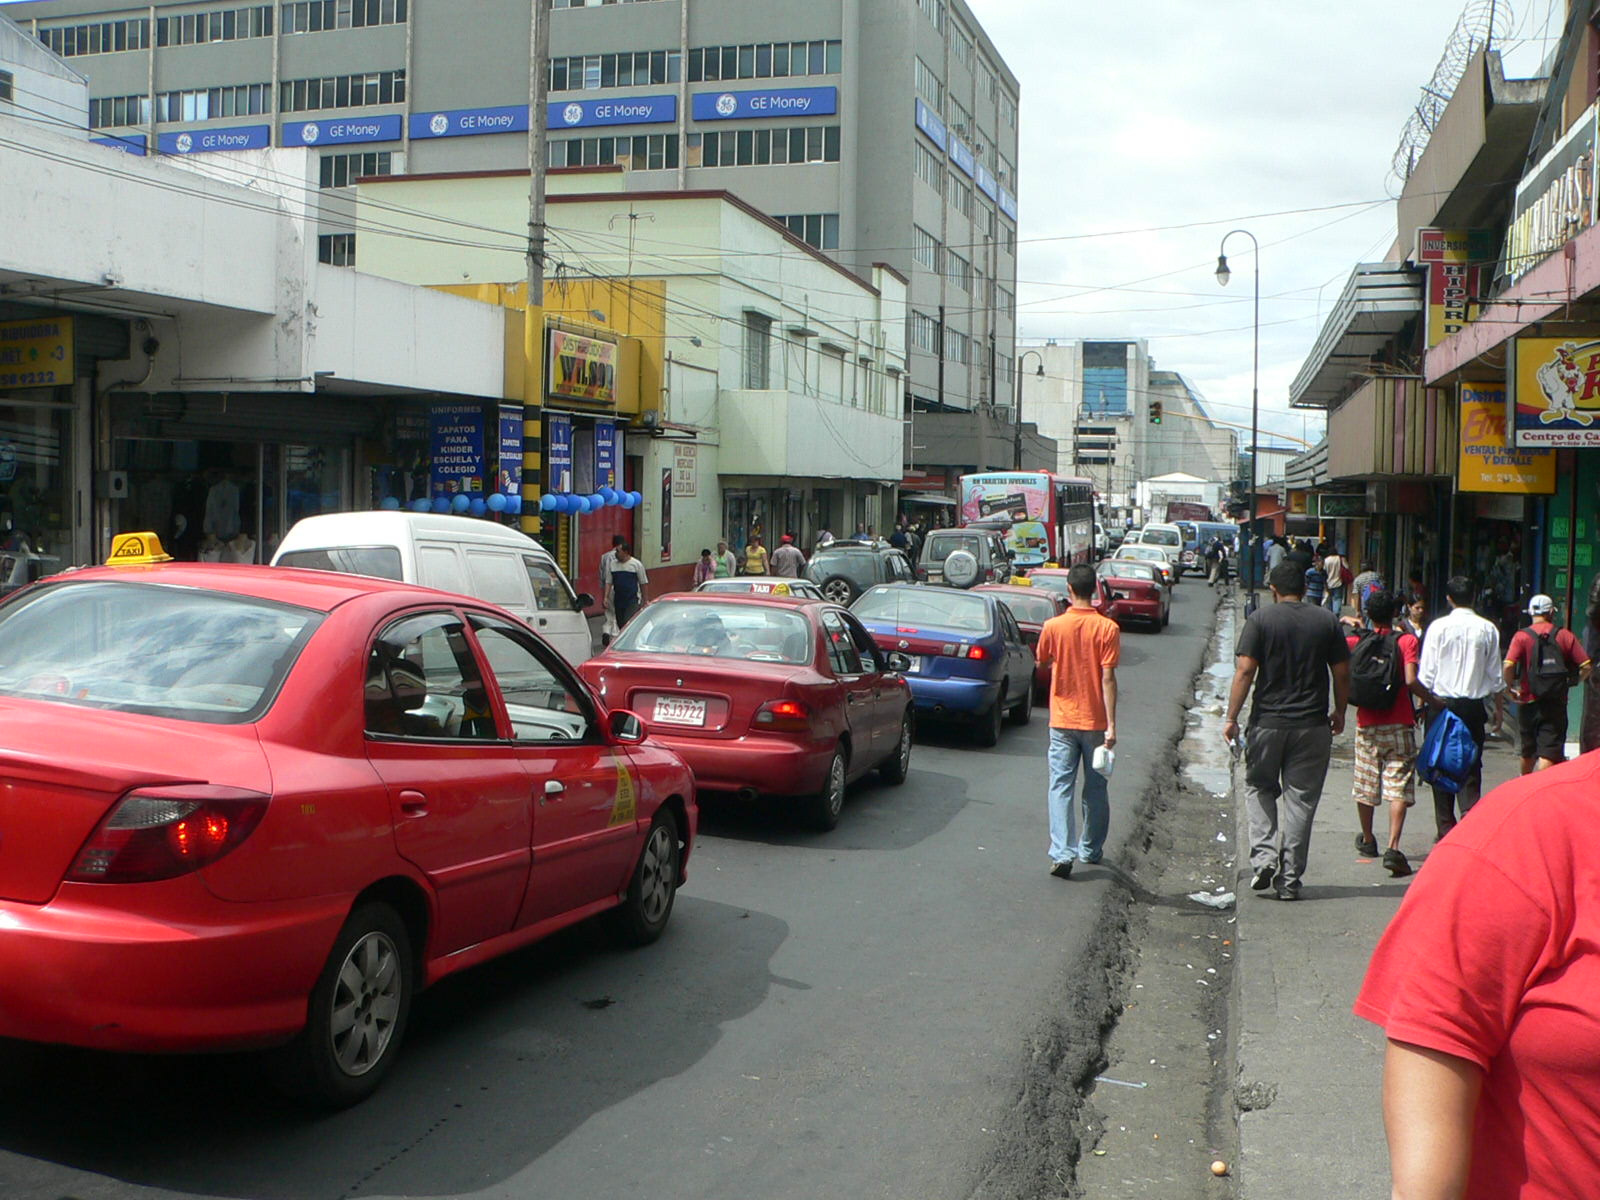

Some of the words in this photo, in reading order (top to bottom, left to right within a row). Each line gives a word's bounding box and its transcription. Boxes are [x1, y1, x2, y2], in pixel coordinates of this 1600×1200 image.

[750, 97, 767, 110] GE
[770, 96, 811, 111] Money
[595, 105, 611, 118] GE
[614, 104, 653, 118] Money
[460, 116, 475, 128] GE
[478, 114, 514, 128] Money
[329, 125, 343, 137] GE
[347, 123, 381, 137] Money
[202, 136, 216, 147] GE
[219, 134, 250, 147] Money
[1423, 240, 1487, 252] INVERSIO
[431, 405, 482, 414] UNIFORMES
[453, 415, 460, 423] Y
[437, 425, 476, 434] ZAPATOS
[445, 436, 468, 444] PARA
[1522, 431, 1565, 442] Centro
[1567, 431, 1581, 442] de
[440, 445, 473, 454] KINDER
[433, 455, 472, 464] ESCUELA
[474, 455, 481, 463] Y
[1483, 456, 1490, 465] Y
[1493, 455, 1534, 466] DETALLE
[438, 465, 477, 474] COLEGIO
[753, 583, 770, 593] TAXI
[657, 702, 704, 719] TSJ3722
